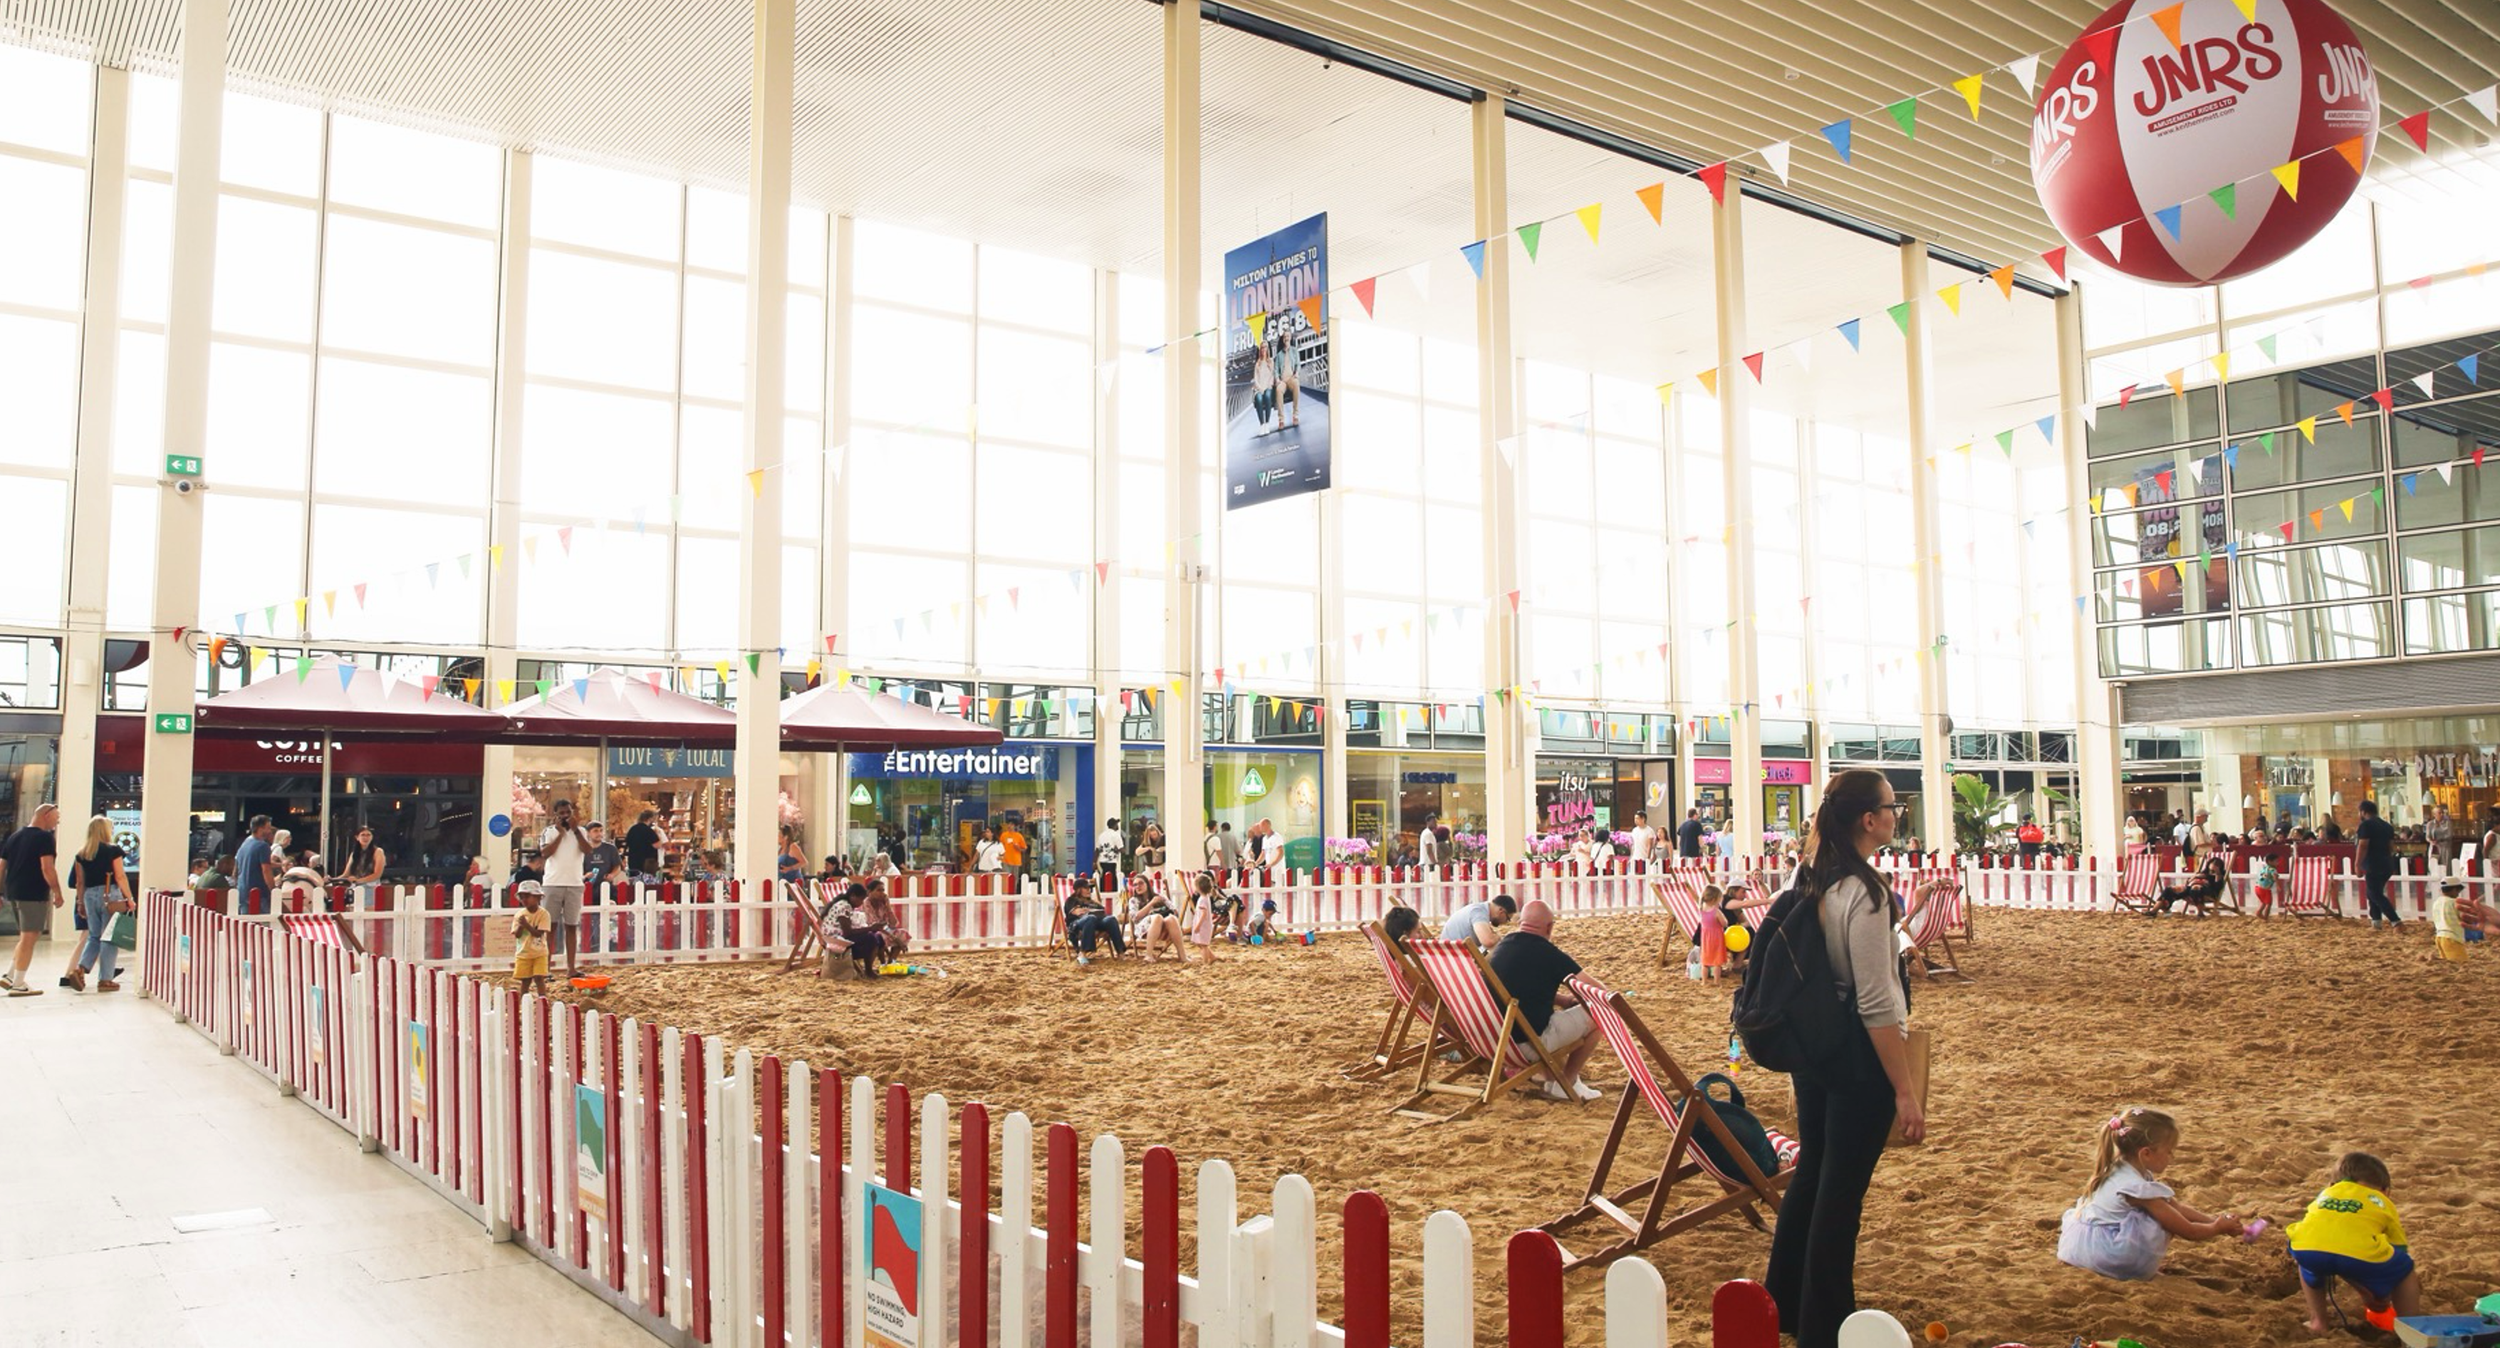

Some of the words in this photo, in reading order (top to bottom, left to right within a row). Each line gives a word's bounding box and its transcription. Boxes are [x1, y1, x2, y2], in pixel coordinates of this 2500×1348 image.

[2133, 22, 2282, 117] JNRS
[2319, 42, 2379, 113] JNR
[2153, 110, 2197, 130] AMUSEMENT
[2198, 103, 2219, 117] RIDES
[2219, 98, 2232, 109] LTD
[1233, 267, 1267, 291] MILTON
[1269, 251, 1306, 276] KEYNES
[1308, 246, 1317, 260] TO
[1231, 260, 1320, 330] LONDON
[1233, 329, 1257, 353] FRO
[1267, 310, 1312, 341] £6.8
[275, 754, 323, 764] COFFEE
[619, 748, 653, 766] LOVE
[687, 749, 726, 767] LOCAL
[896, 748, 1041, 774] Entertainer
[2415, 752, 2456, 779] PRET
[2463, 752, 2475, 777] A
[1560, 771, 1588, 792] itsu
[1547, 797, 1596, 826] TUNA
[867, 1291, 875, 1302] NO
[867, 1303, 880, 1317] HIGH
[881, 1309, 904, 1328] HAZARD
